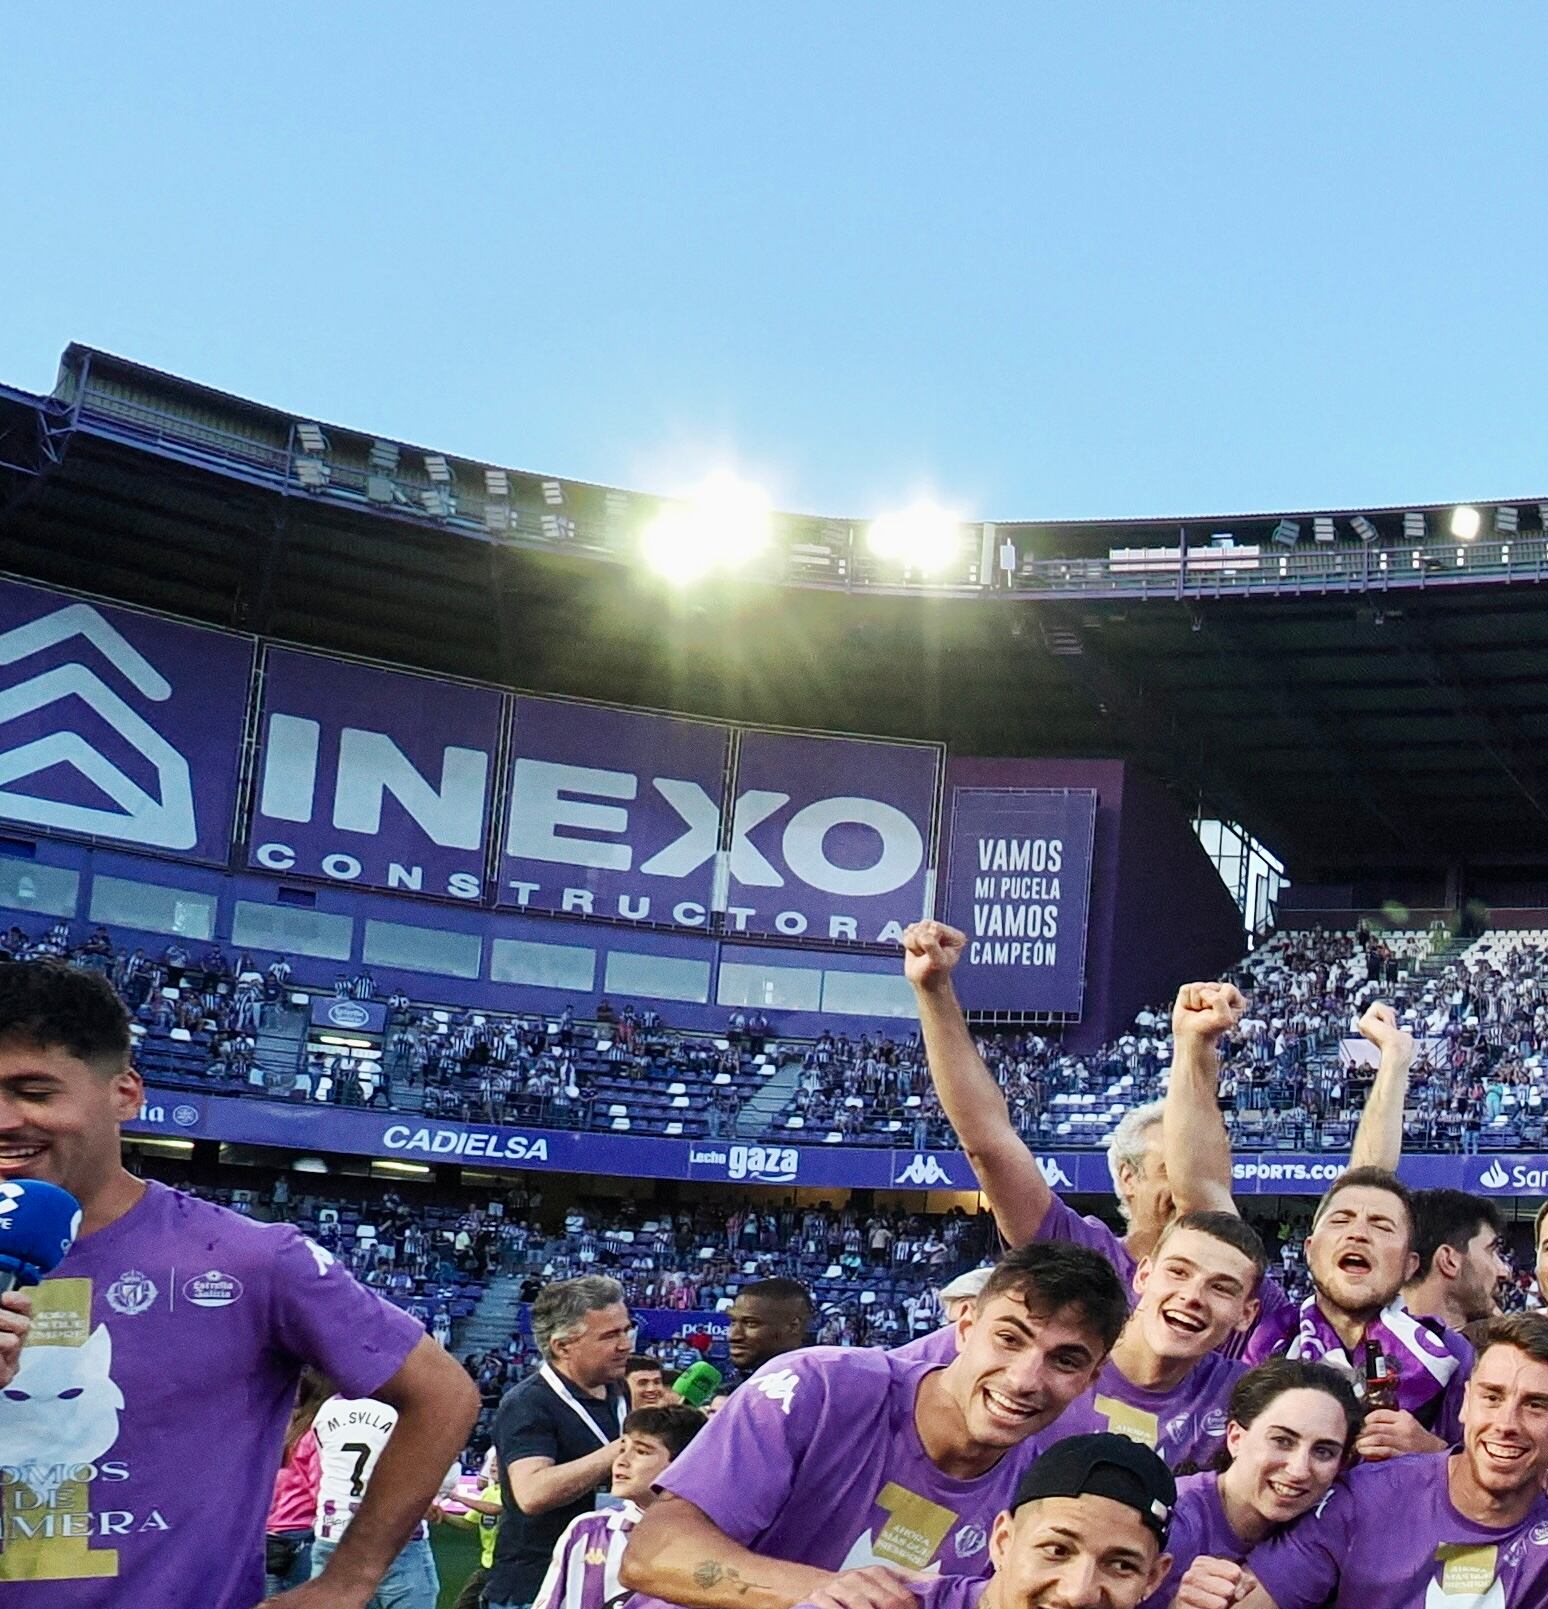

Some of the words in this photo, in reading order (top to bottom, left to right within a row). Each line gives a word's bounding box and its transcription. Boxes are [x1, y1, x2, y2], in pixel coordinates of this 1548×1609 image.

[261, 713, 924, 896] INEXO
[978, 839, 1062, 872] VAMOS
[257, 843, 904, 943] CONSTRUCTORA
[975, 878, 994, 899] MI
[1000, 877, 1060, 900] PUCELA
[973, 904, 1058, 938] VAMOS
[970, 939, 1056, 966] CAMPEÓN
[383, 1125, 549, 1161] CADIELSA
[728, 1147, 798, 1180] gaza
[0, 1461, 130, 1485] OMOS
[341, 1443, 371, 1496] 7
[0, 1509, 172, 1540] MERA
